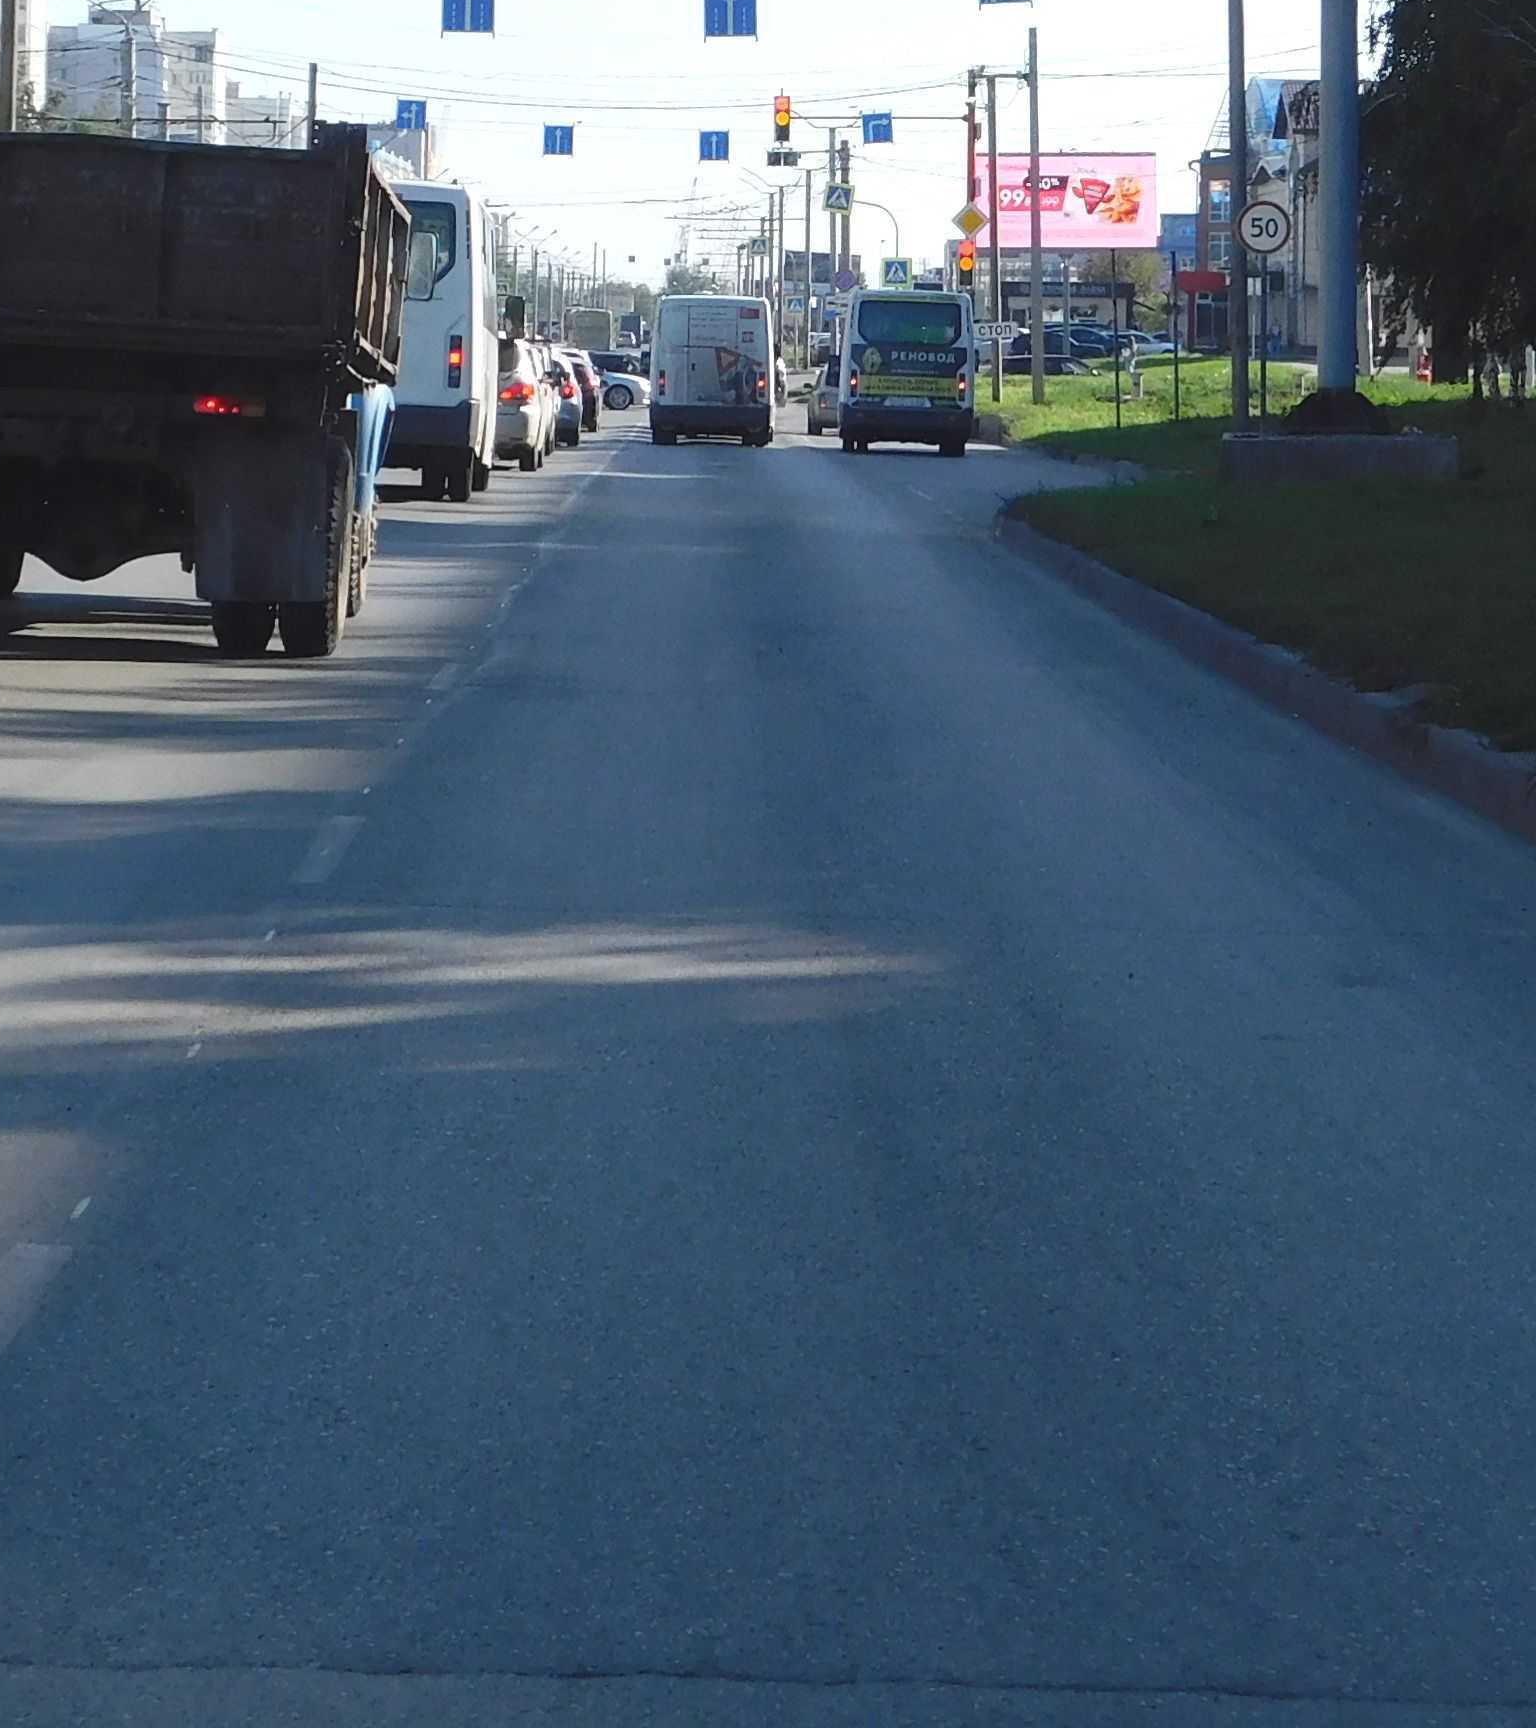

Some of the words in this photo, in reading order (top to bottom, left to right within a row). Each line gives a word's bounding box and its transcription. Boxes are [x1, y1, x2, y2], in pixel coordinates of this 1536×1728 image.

[1250, 217, 1279, 239] 50
[978, 324, 1012, 337] СТОП
[890, 350, 956, 364] РЕНОВОД
